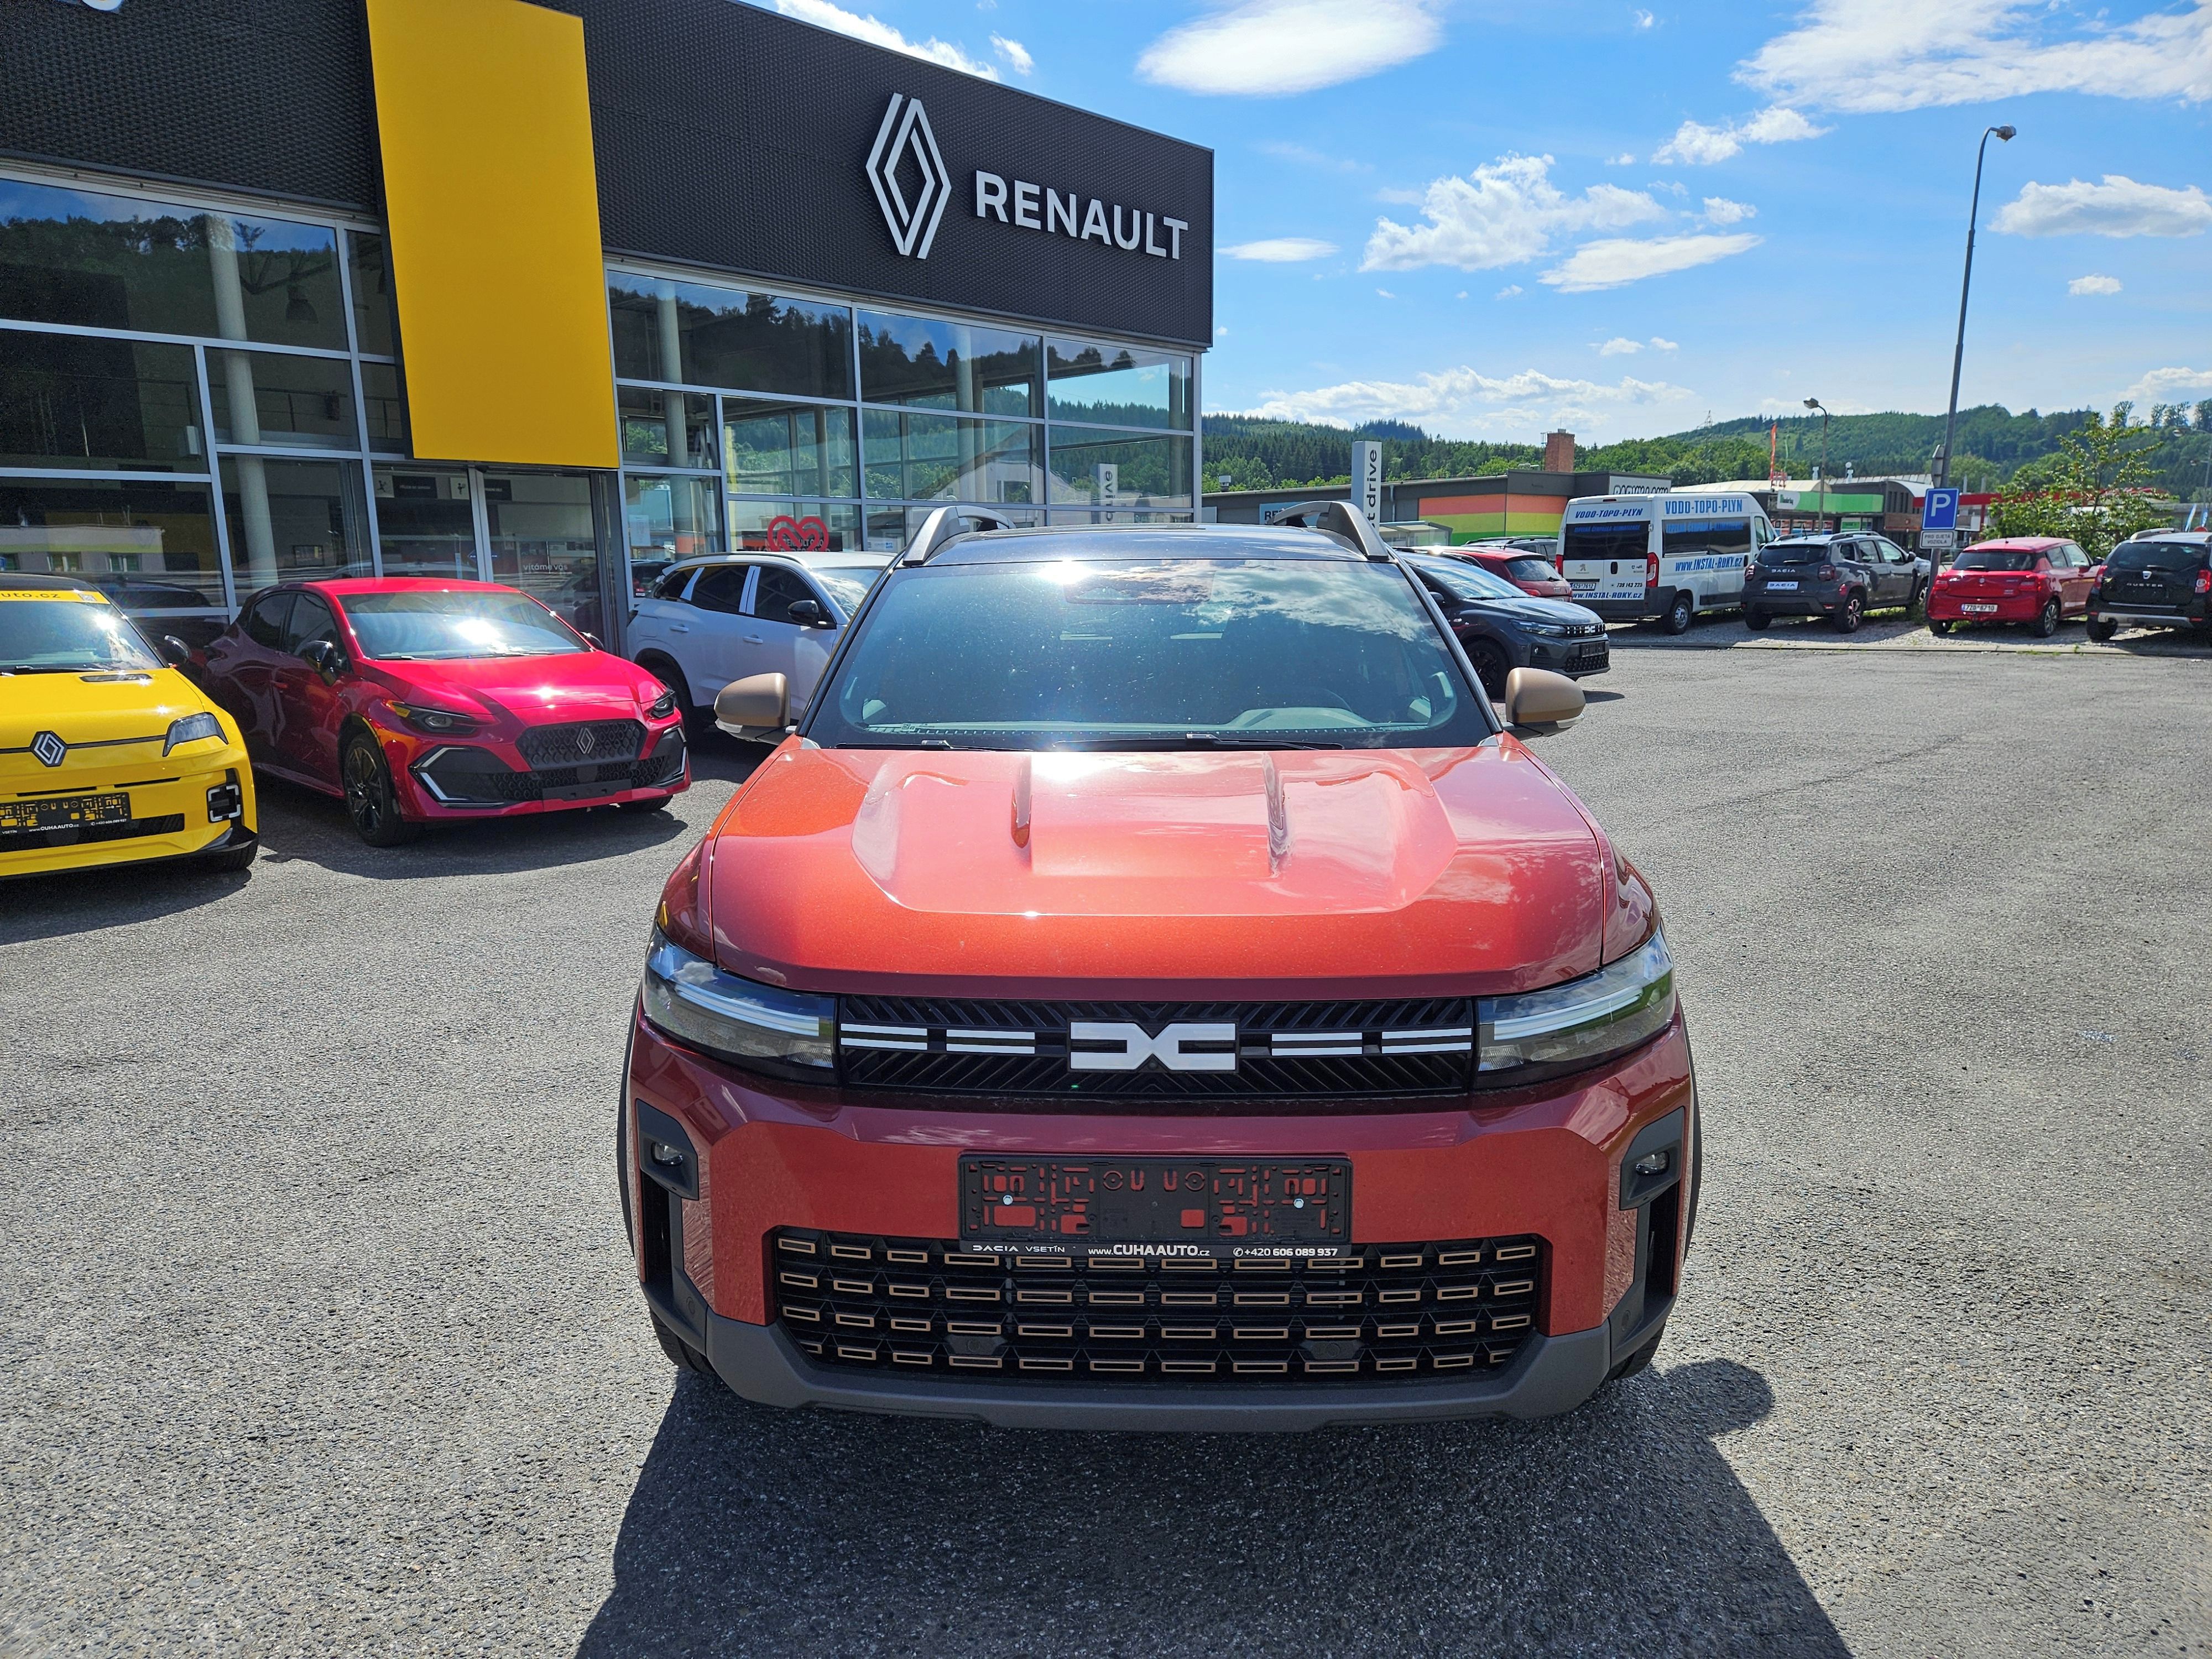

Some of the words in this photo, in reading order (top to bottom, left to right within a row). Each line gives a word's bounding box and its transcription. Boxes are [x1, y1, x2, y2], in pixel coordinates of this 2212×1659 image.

[976, 170, 1188, 260] RENAULT
[1366, 450, 1377, 507] drive
[1665, 499, 1743, 514] VODO-TOPO-PLYN
[1931, 493, 1951, 517] P
[1575, 508, 1643, 518] VODO-TOPO-PLYN
[29, 823, 79, 832] www.CUHAAUTO.cz
[1025, 1244, 1065, 1253] VSETÍN
[1088, 1244, 1210, 1256] www.CUHAAUTO.cz
[1244, 1248, 1271, 1256] +420
[1272, 1248, 1293, 1256] 606
[1295, 1248, 1316, 1256] 089
[1317, 1248, 1338, 1256] 937
